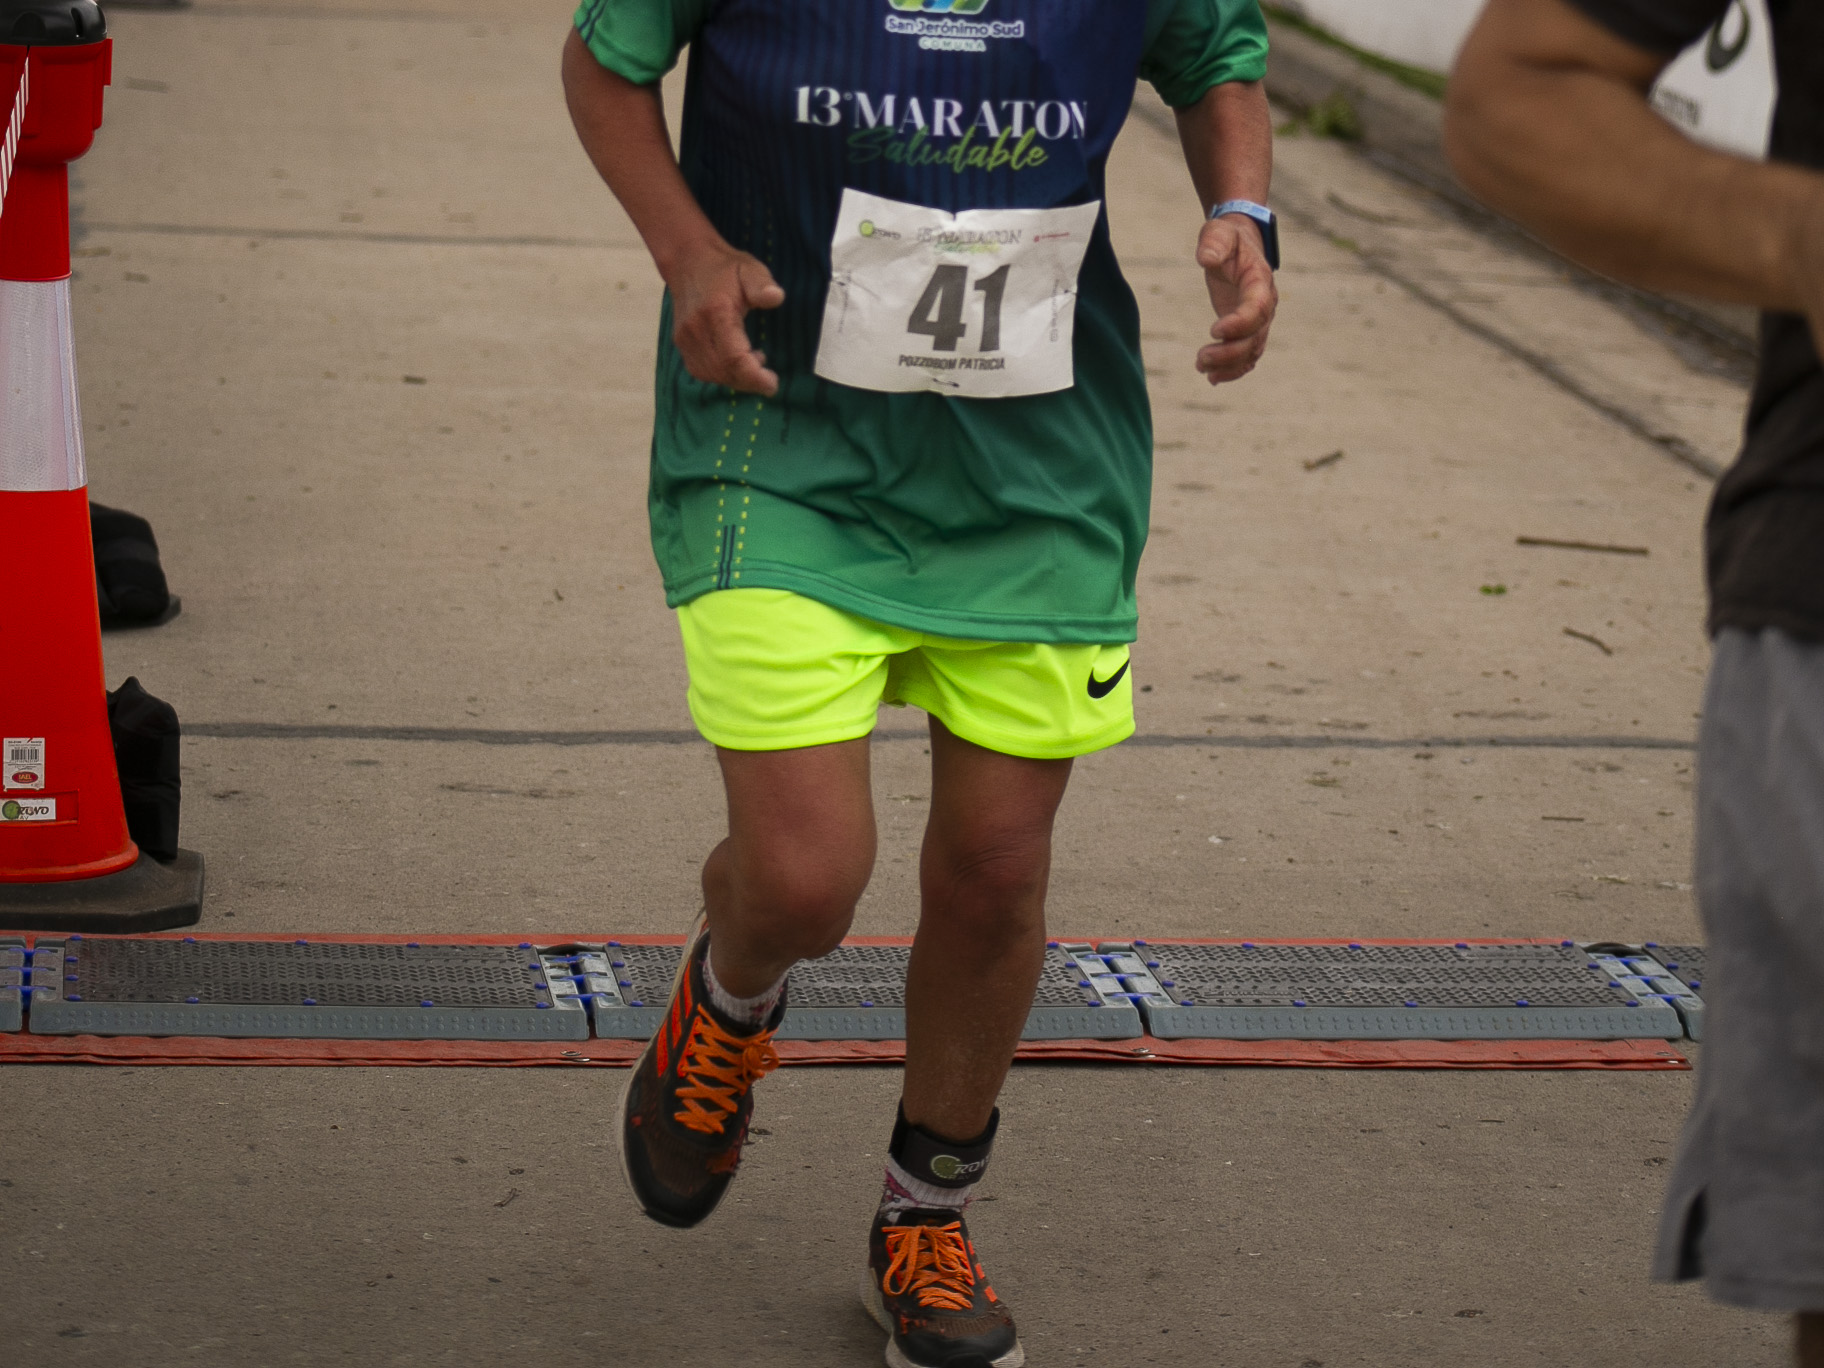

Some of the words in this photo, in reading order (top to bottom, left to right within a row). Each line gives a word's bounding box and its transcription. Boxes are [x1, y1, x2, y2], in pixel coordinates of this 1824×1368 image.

[888, 17, 914, 31] San
[917, 19, 989, 36] Jerónimo
[991, 21, 1021, 36] Sud
[922, 38, 985, 50] COMUNA
[846, 125, 1048, 173] Saludable
[907, 264, 1011, 352] 41
[958, 356, 1006, 371] PATRICIA
